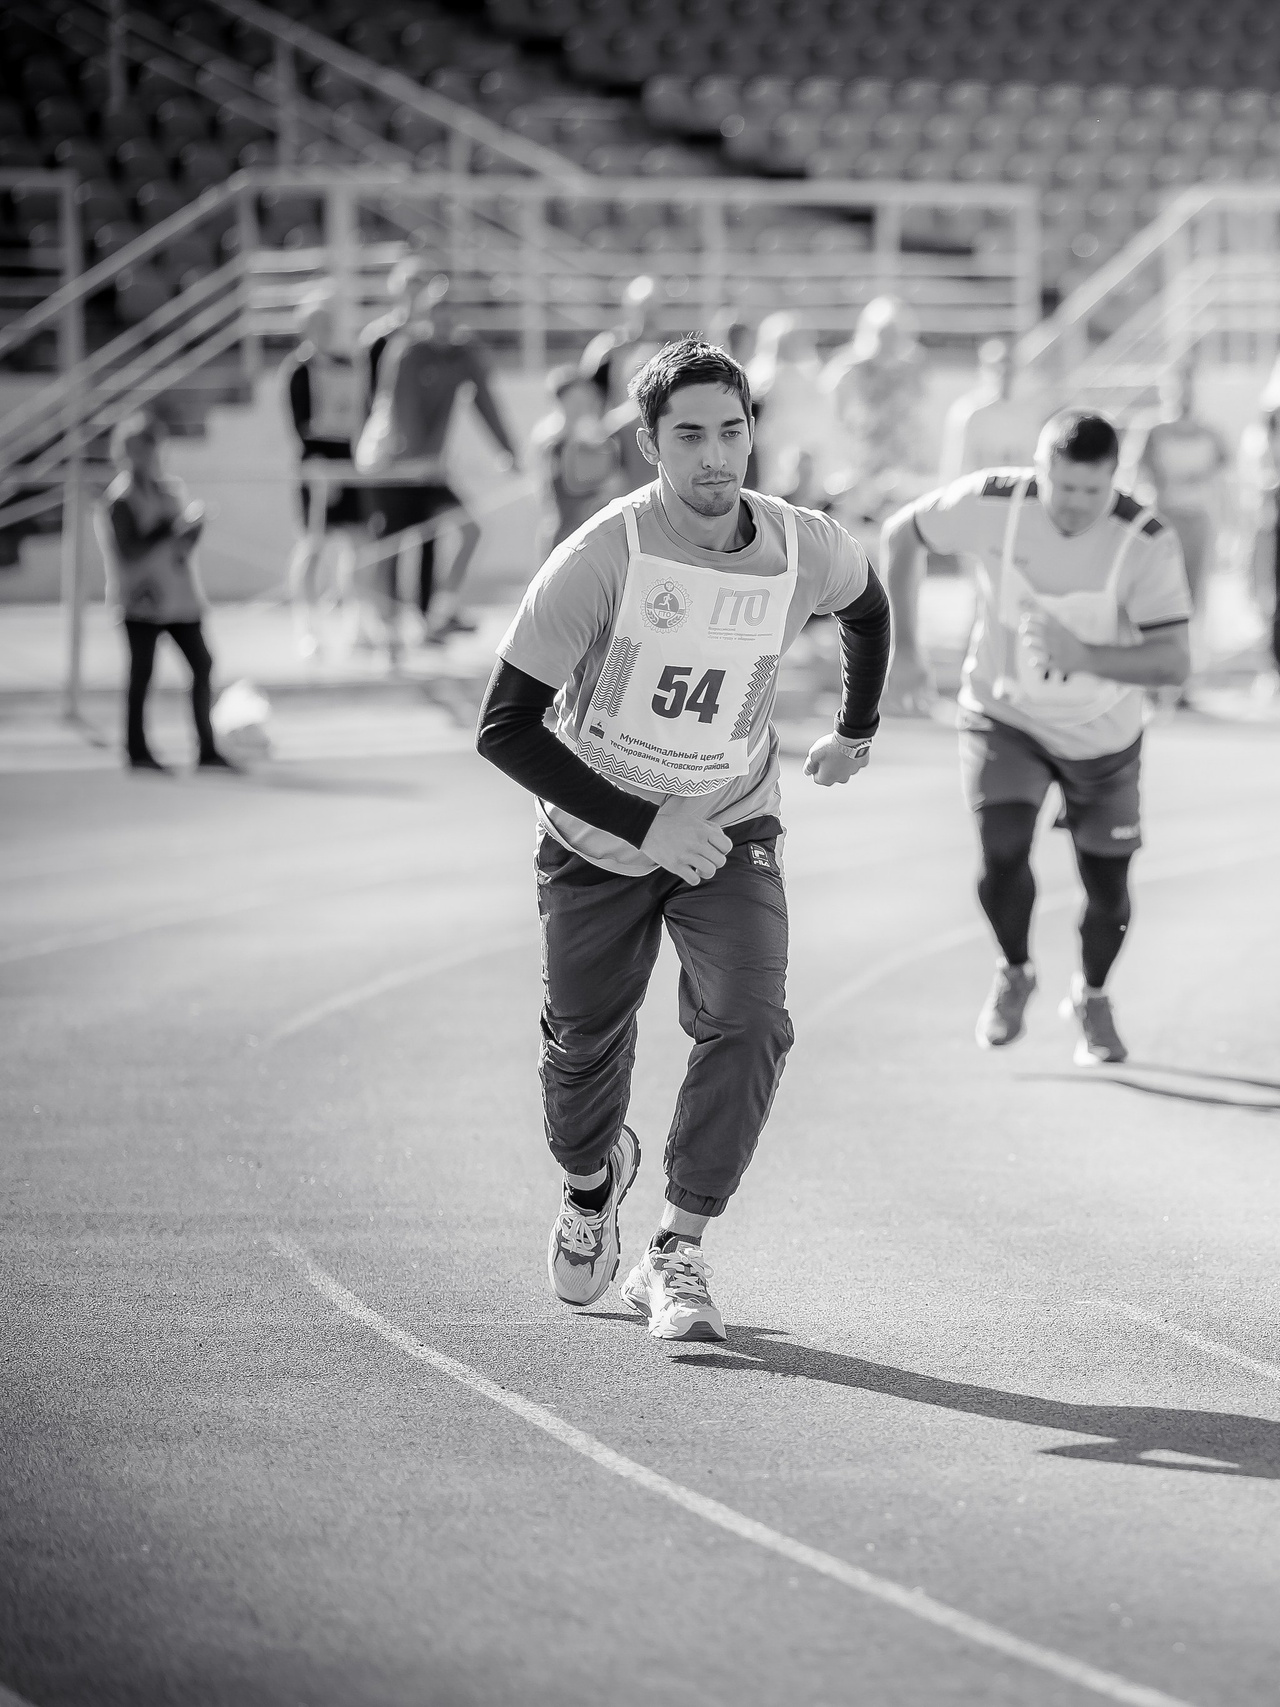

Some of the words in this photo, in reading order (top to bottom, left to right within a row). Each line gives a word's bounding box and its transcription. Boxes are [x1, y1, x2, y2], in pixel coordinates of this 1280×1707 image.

[658, 610, 672, 618] ГТО
[710, 587, 770, 627] ГТО
[651, 665, 726, 724] 54
[610, 739, 660, 763] тестирования
[661, 758, 703, 772] Кстовского
[703, 762, 730, 772] района
[619, 732, 698, 760] Муниципальный
[700, 752, 725, 762] центр
